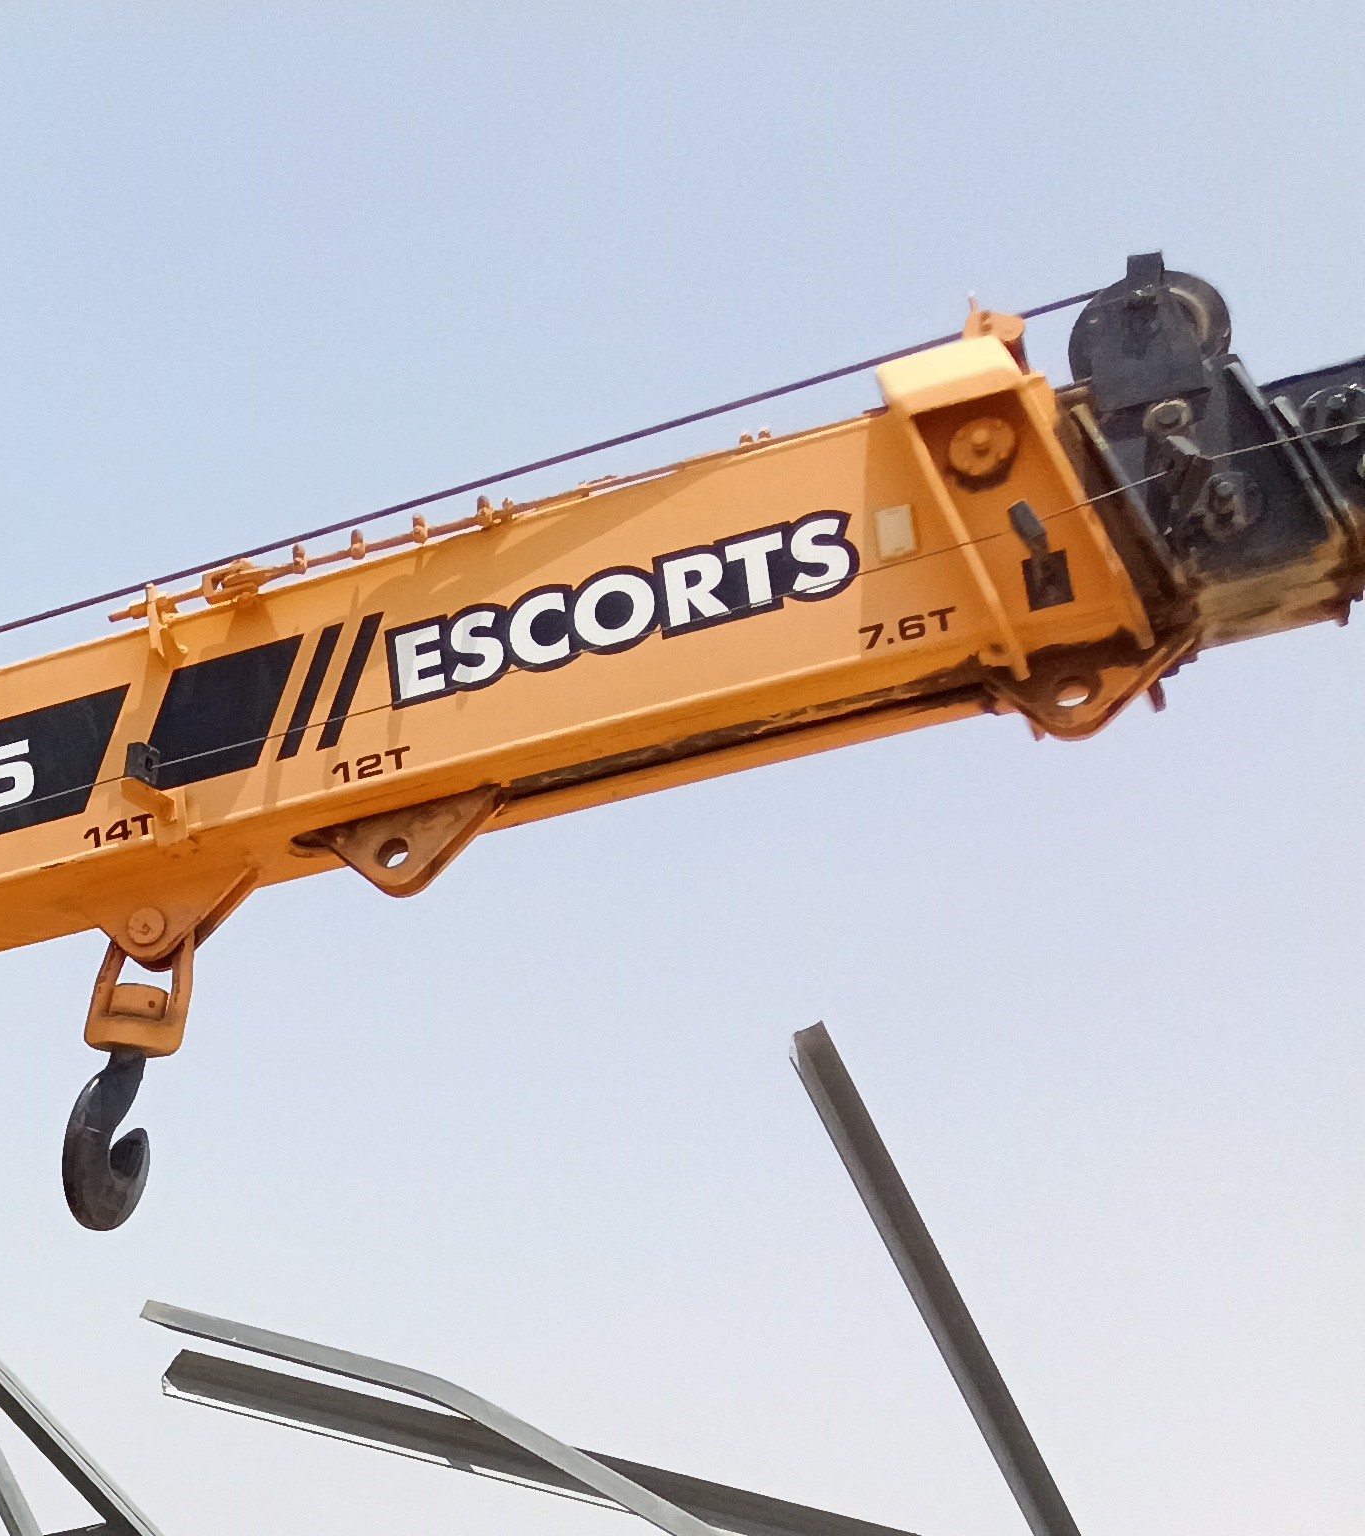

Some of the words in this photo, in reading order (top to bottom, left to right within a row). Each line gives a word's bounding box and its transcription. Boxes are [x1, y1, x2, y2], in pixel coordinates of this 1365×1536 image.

[395, 516, 851, 701] ESCORTS
[859, 606, 957, 650] 7.6T
[332, 746, 411, 782] 12T
[84, 813, 155, 849] 14T
